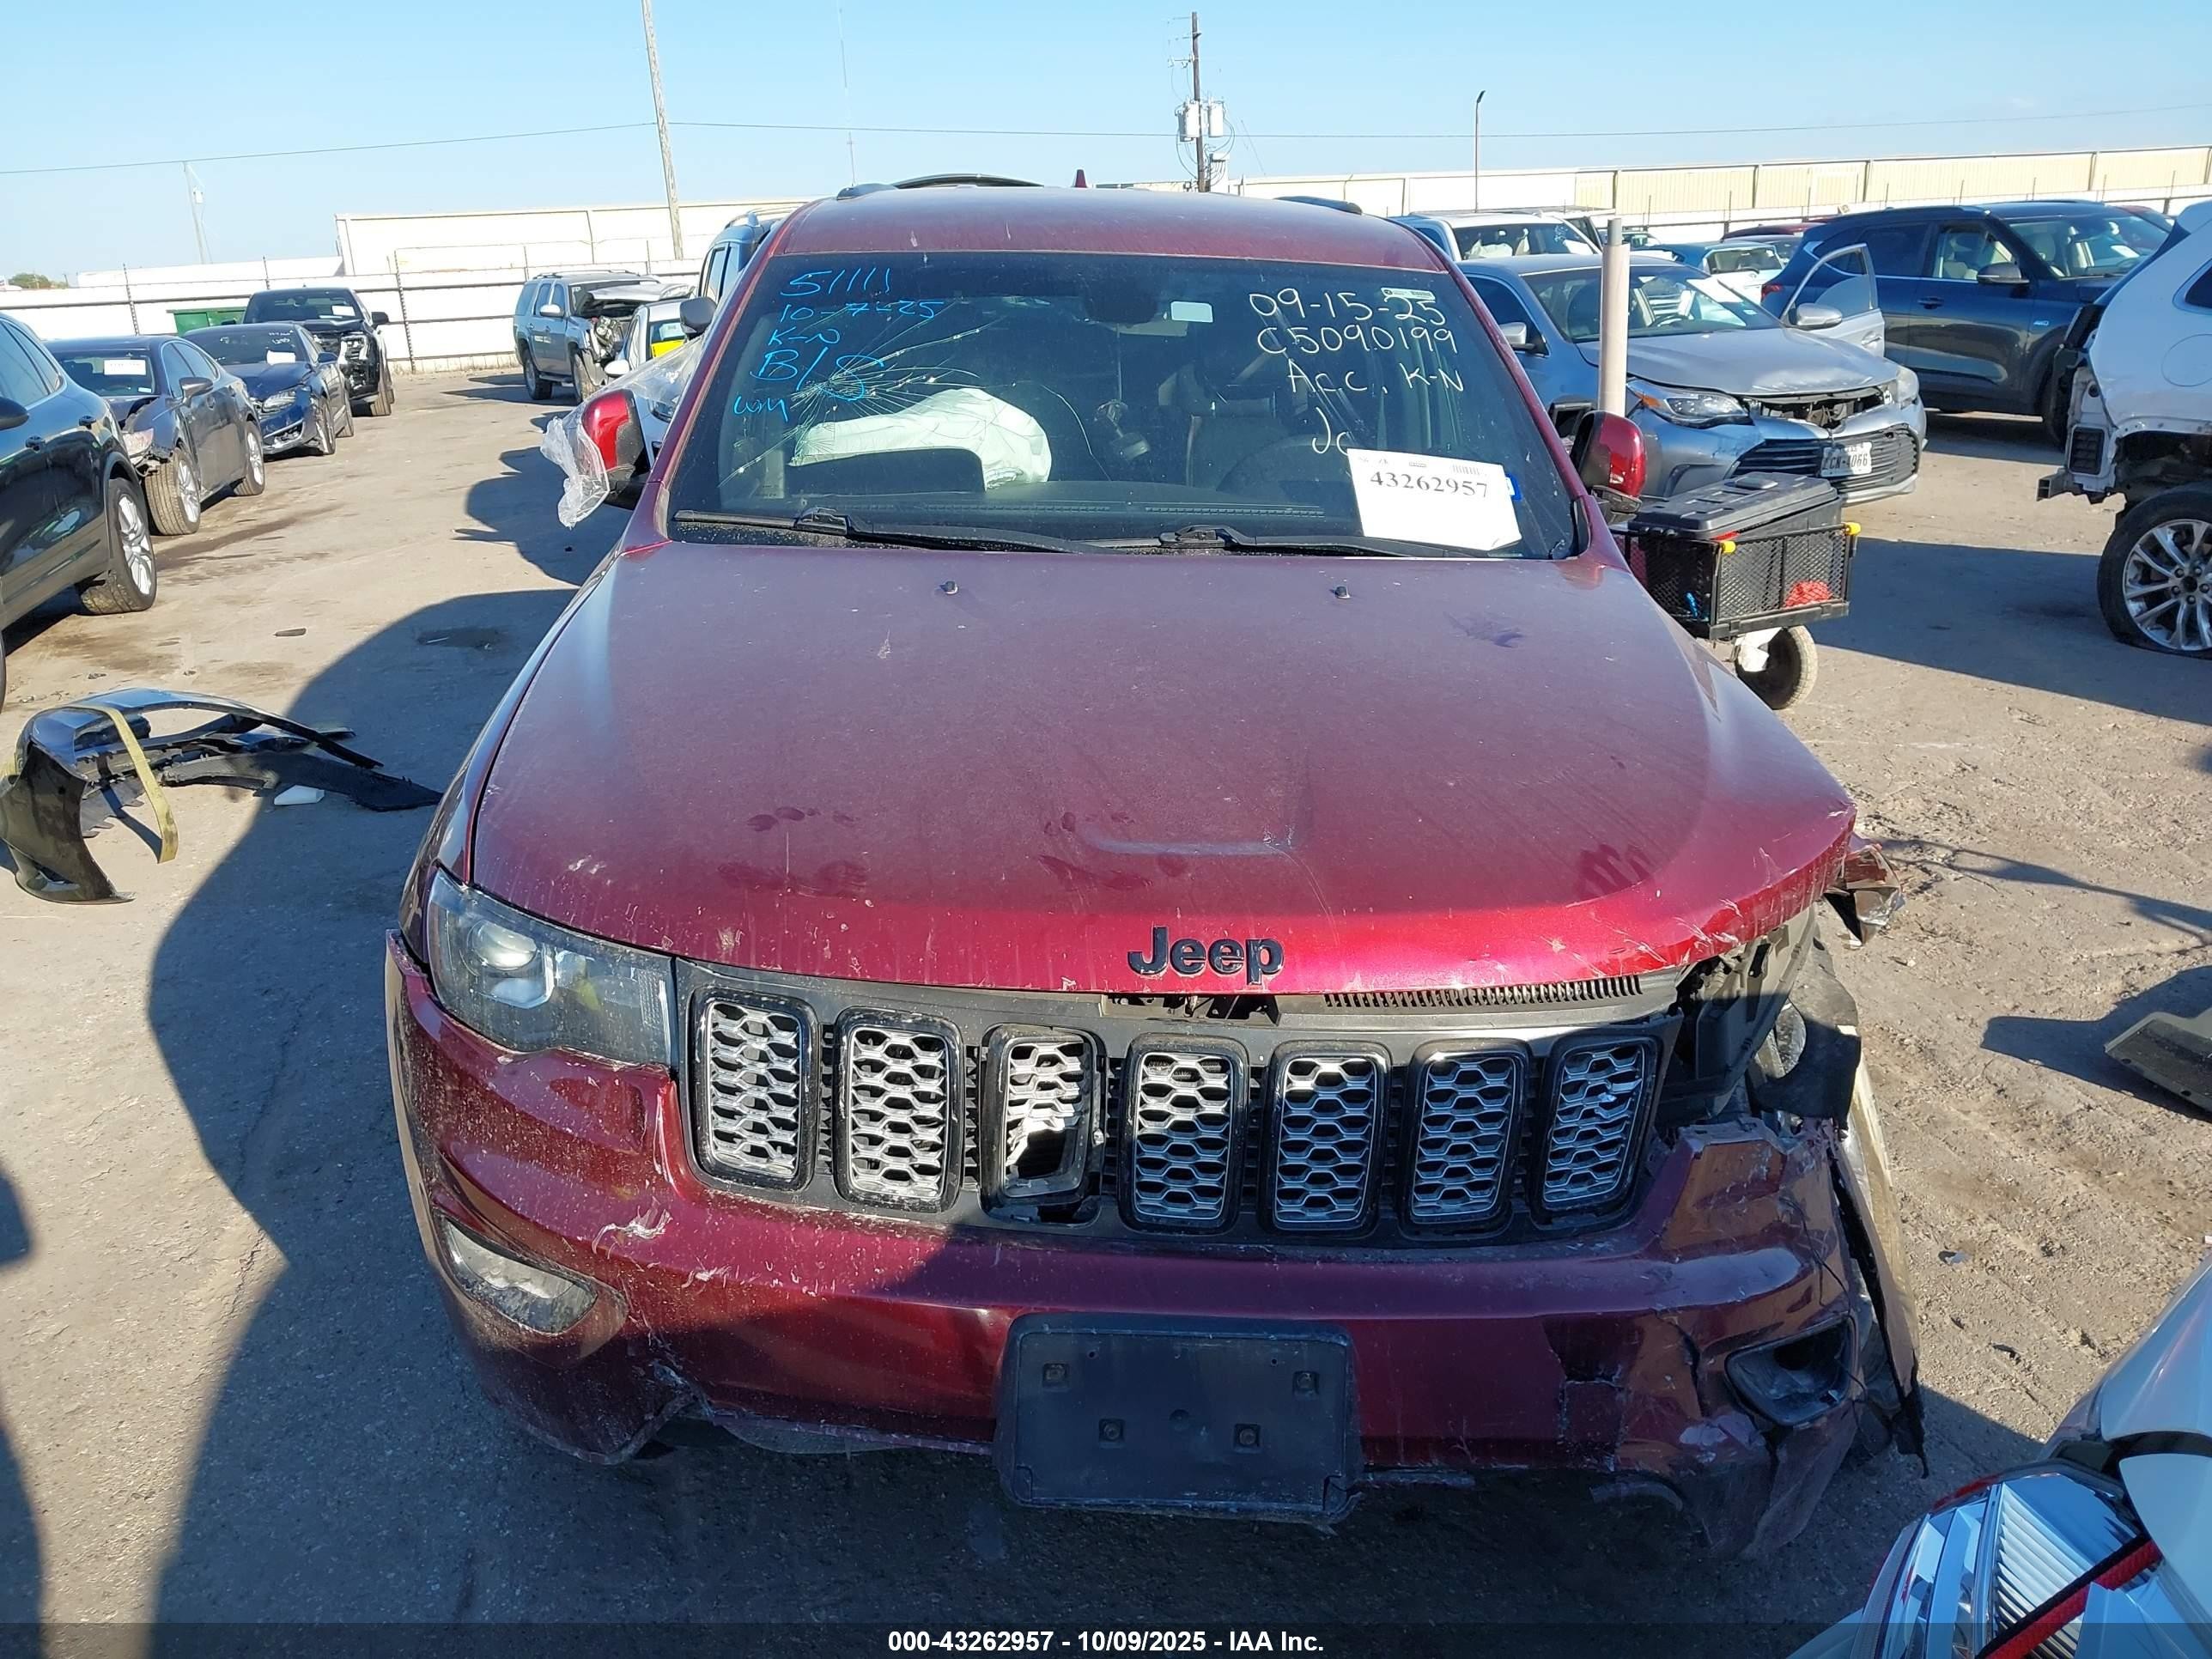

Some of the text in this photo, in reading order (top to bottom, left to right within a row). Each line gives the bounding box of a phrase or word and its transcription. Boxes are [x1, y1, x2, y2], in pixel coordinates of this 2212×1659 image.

[1249, 289, 1446, 325] 09-15-25
[1257, 325, 1458, 354] C5090199
[1369, 471, 1488, 499] 43262957
[1127, 925, 1285, 986] Jeep
